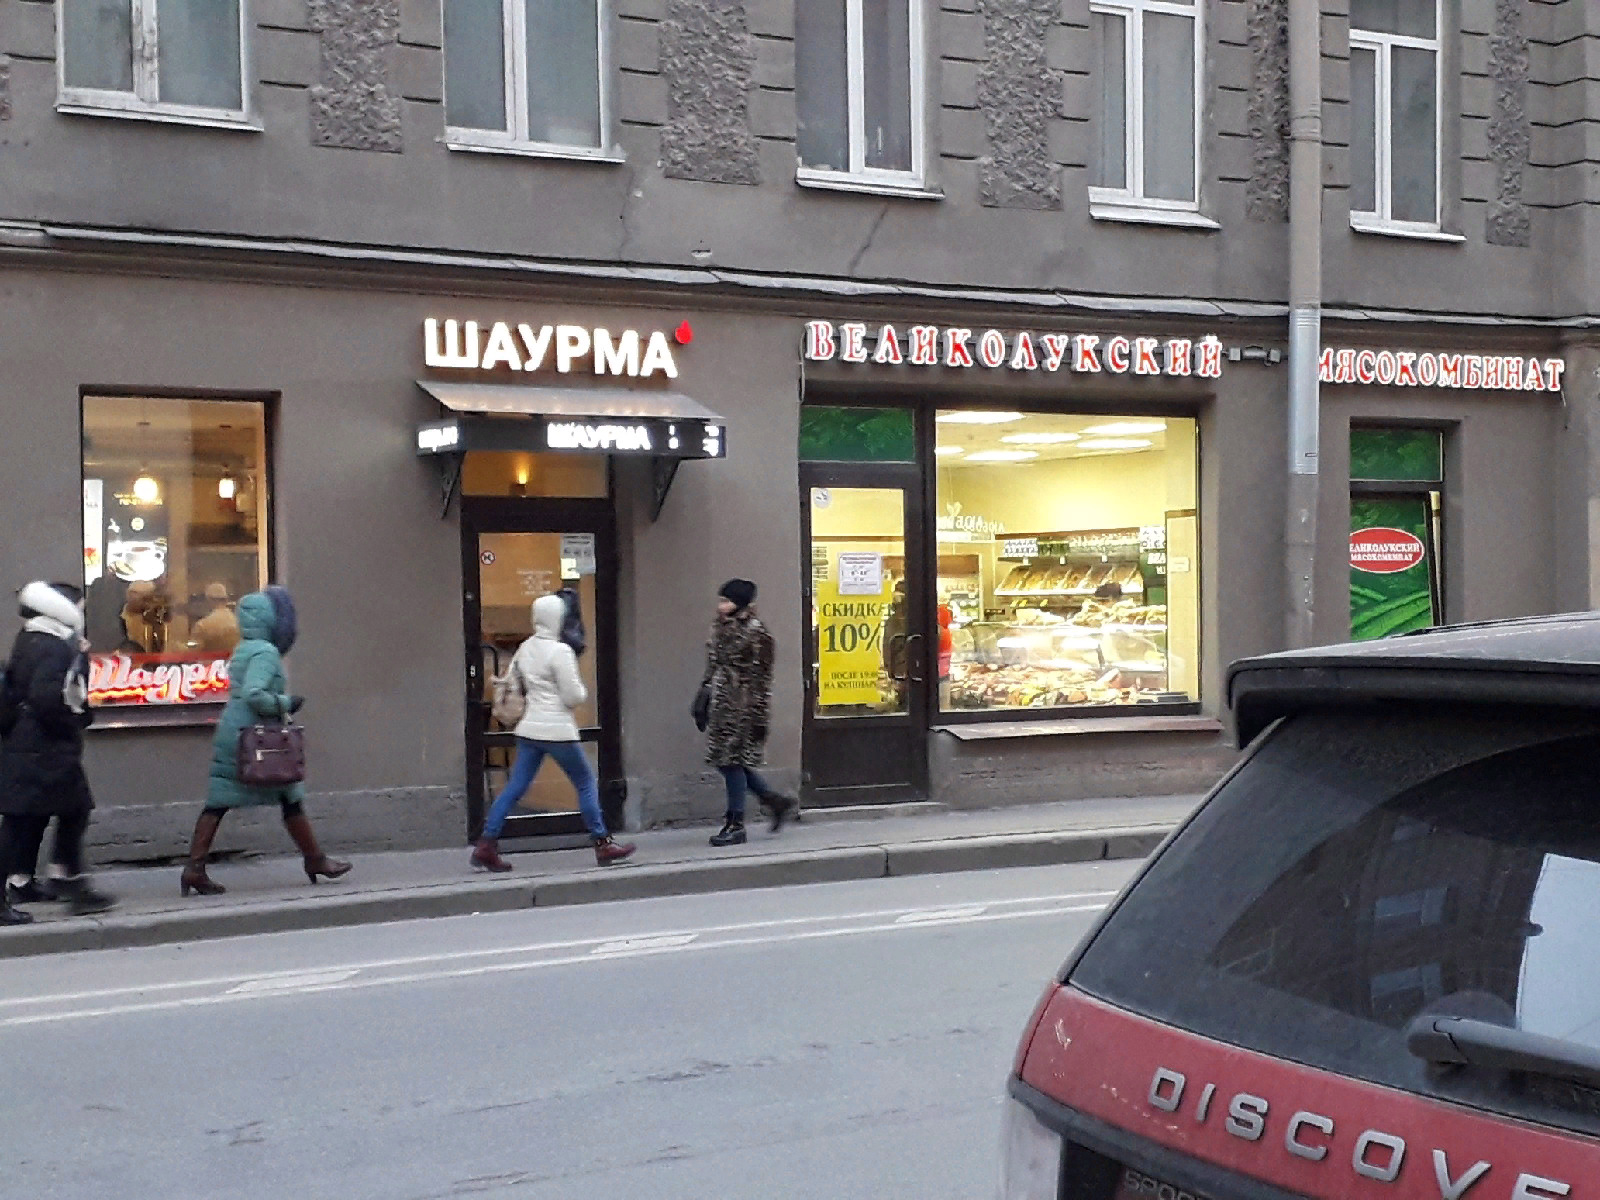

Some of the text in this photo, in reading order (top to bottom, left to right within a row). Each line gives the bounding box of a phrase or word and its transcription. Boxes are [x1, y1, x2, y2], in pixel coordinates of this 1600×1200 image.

[424, 318, 678, 378] ШАУРМА
[805, 320, 1223, 378] ВЕЛИКОЛУКСКИЙ
[1349, 543, 1420, 552] ЕЛИКОЛУКСКИЙ
[824, 623, 882, 653] 10%
